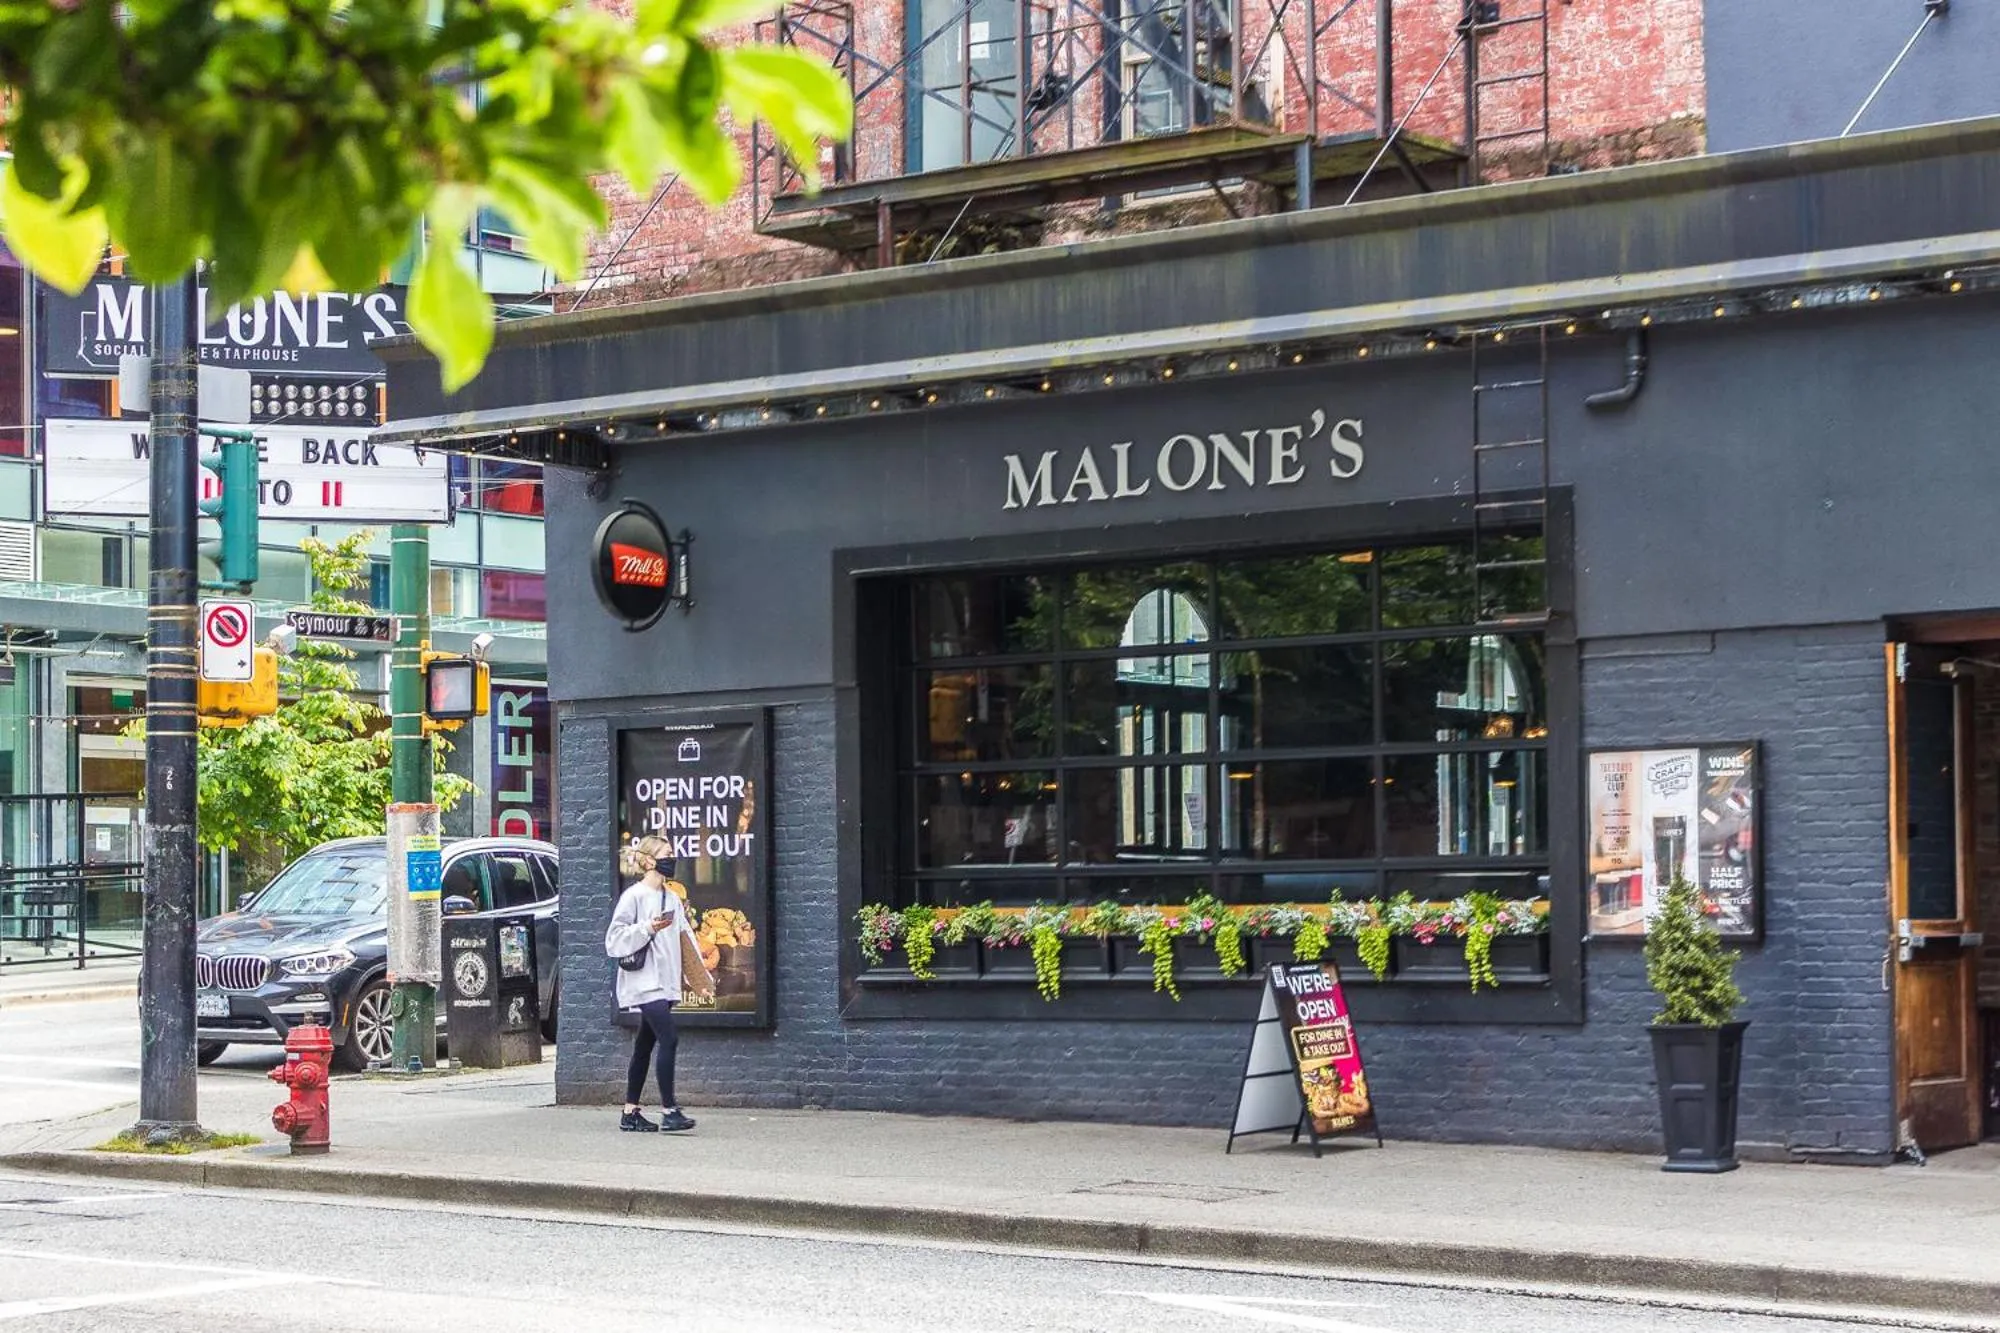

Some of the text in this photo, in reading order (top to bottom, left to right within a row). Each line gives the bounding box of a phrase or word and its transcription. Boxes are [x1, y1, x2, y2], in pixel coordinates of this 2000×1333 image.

[96, 284, 397, 348] MLONE'S
[94, 344, 147, 357] SOCIAL
[223, 347, 299, 362] TAPHOUSE
[302, 438, 379, 466] BACK
[1002, 408, 1364, 510] MALONE'S
[289, 612, 350, 635] Seymour
[1655, 763, 1685, 779] CRAFT
[1708, 757, 1745, 769] WINE
[636, 775, 745, 802] OPEN FOR
[651, 804, 728, 830] DINE IN
[706, 833, 754, 857] OUT
[1711, 867, 1742, 878] HALF
[1709, 879, 1743, 889] PRICE
[1286, 973, 1333, 995] WE'RE
[1297, 999, 1337, 1020] OPEN
[1299, 1032, 1316, 1044] FOR
[1310, 1044, 1330, 1057] TAKE
[1330, 1041, 1345, 1053] OUT
